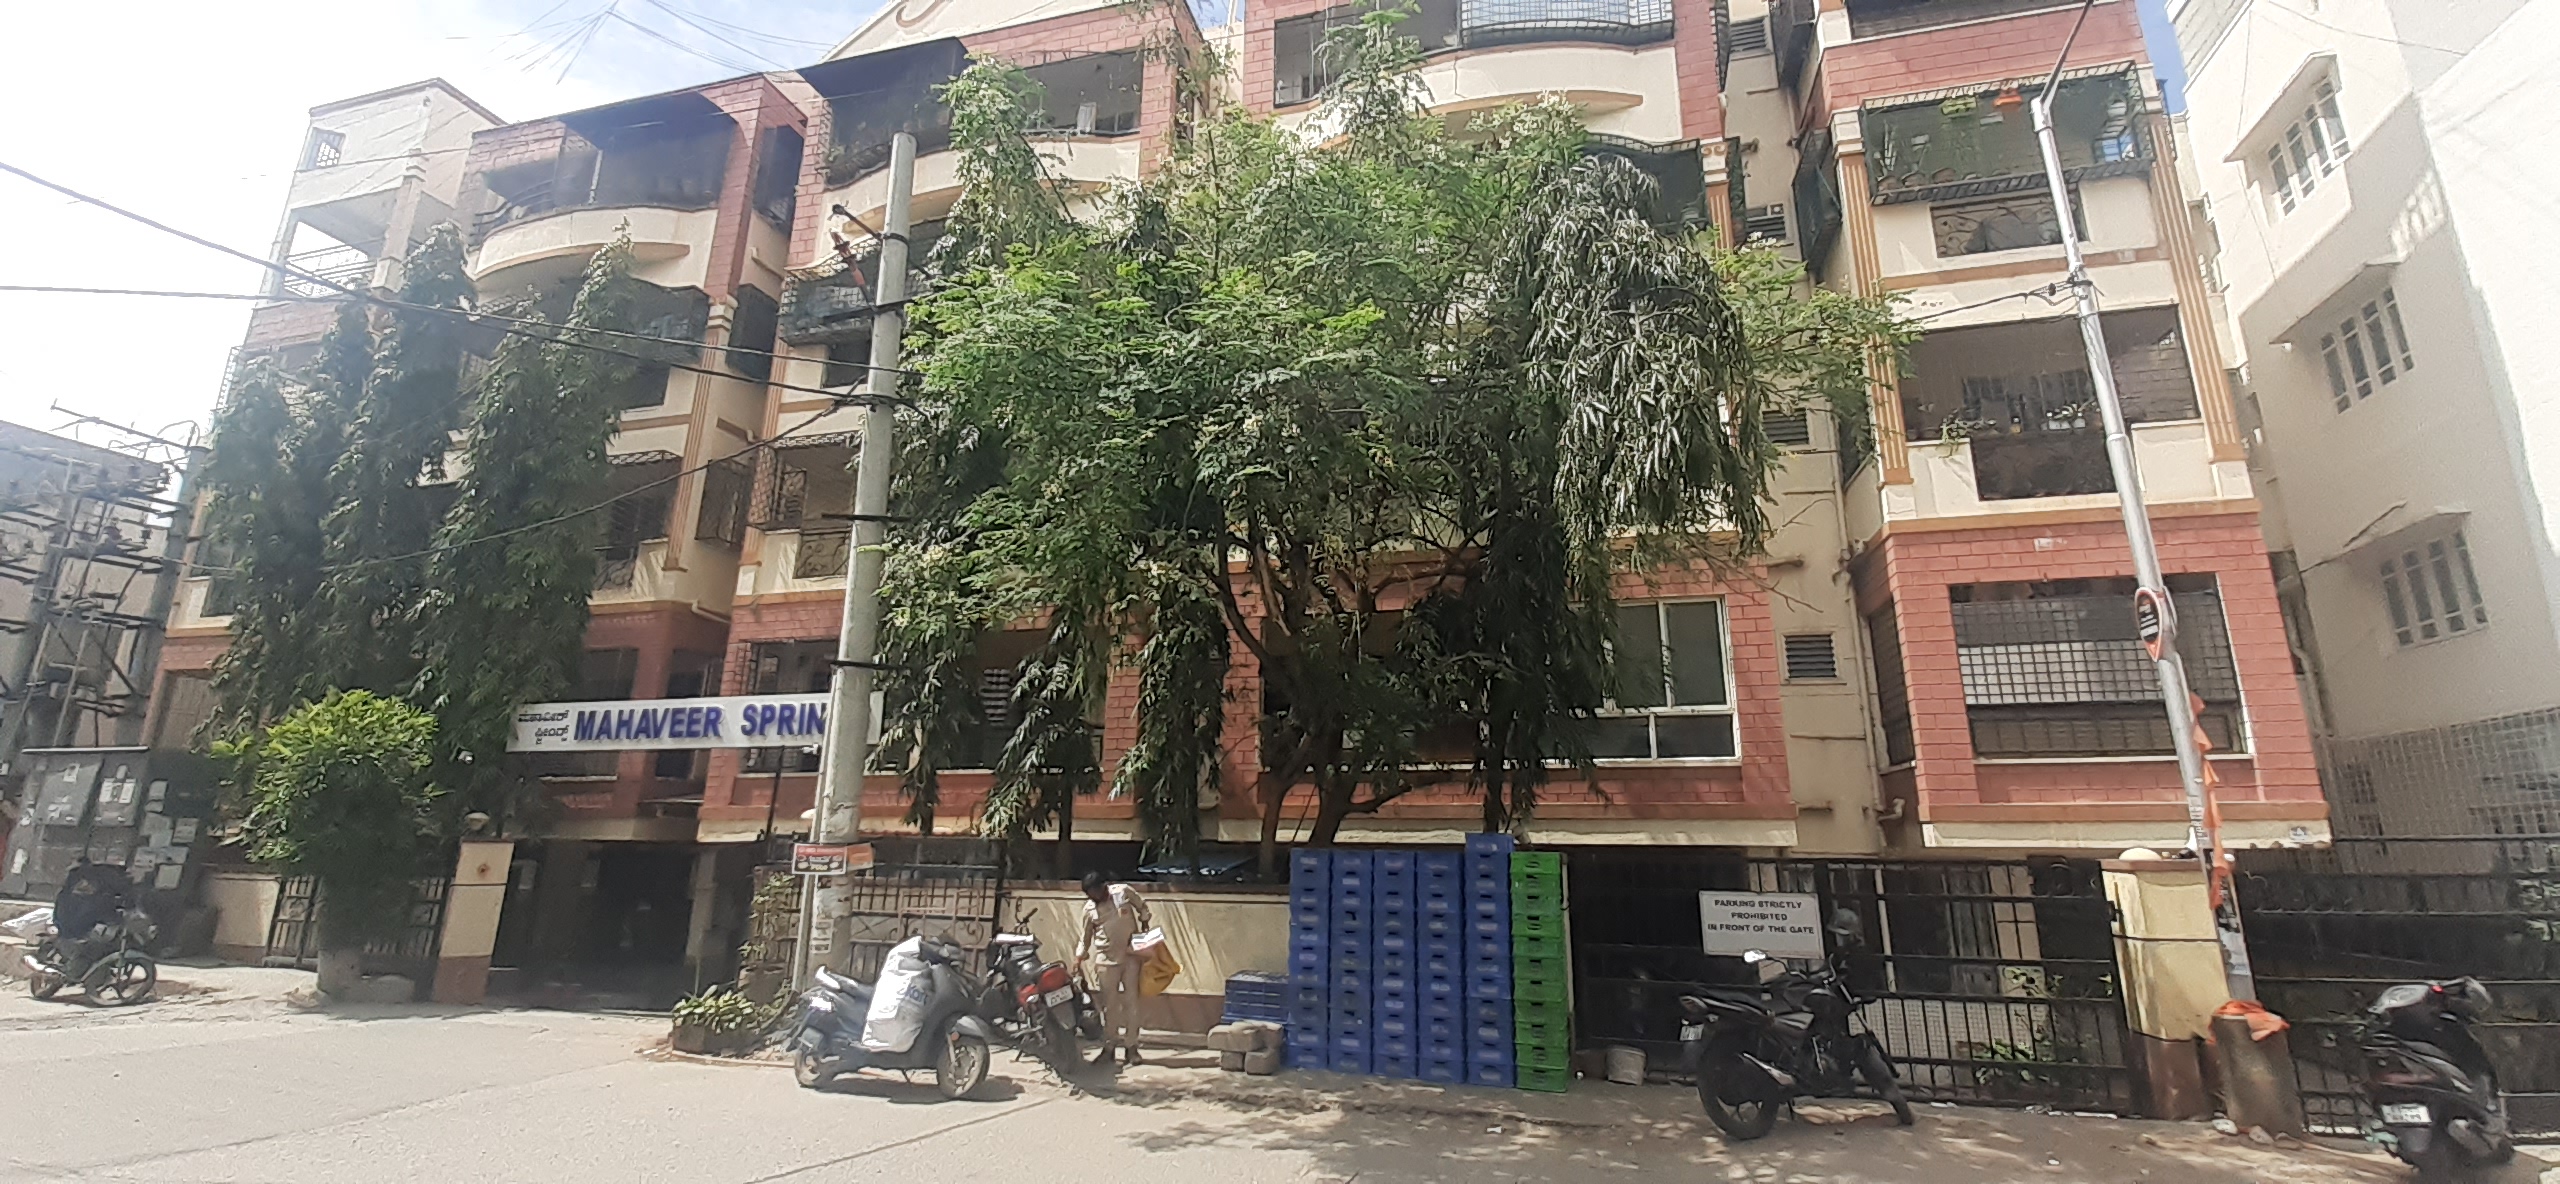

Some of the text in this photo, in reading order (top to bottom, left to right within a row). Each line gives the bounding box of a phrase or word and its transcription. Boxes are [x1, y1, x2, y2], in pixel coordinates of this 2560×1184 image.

[573, 703, 829, 740] MAHAVEER SPRIN
[1714, 899, 1802, 909] PARKING STRICTLY
[1731, 912, 1788, 921] PROHIBITED
[1707, 923, 1717, 931] IN
[1719, 924, 1751, 932] FRONT
[1768, 925, 1787, 933] THE
[1789, 926, 1815, 934] GATE
